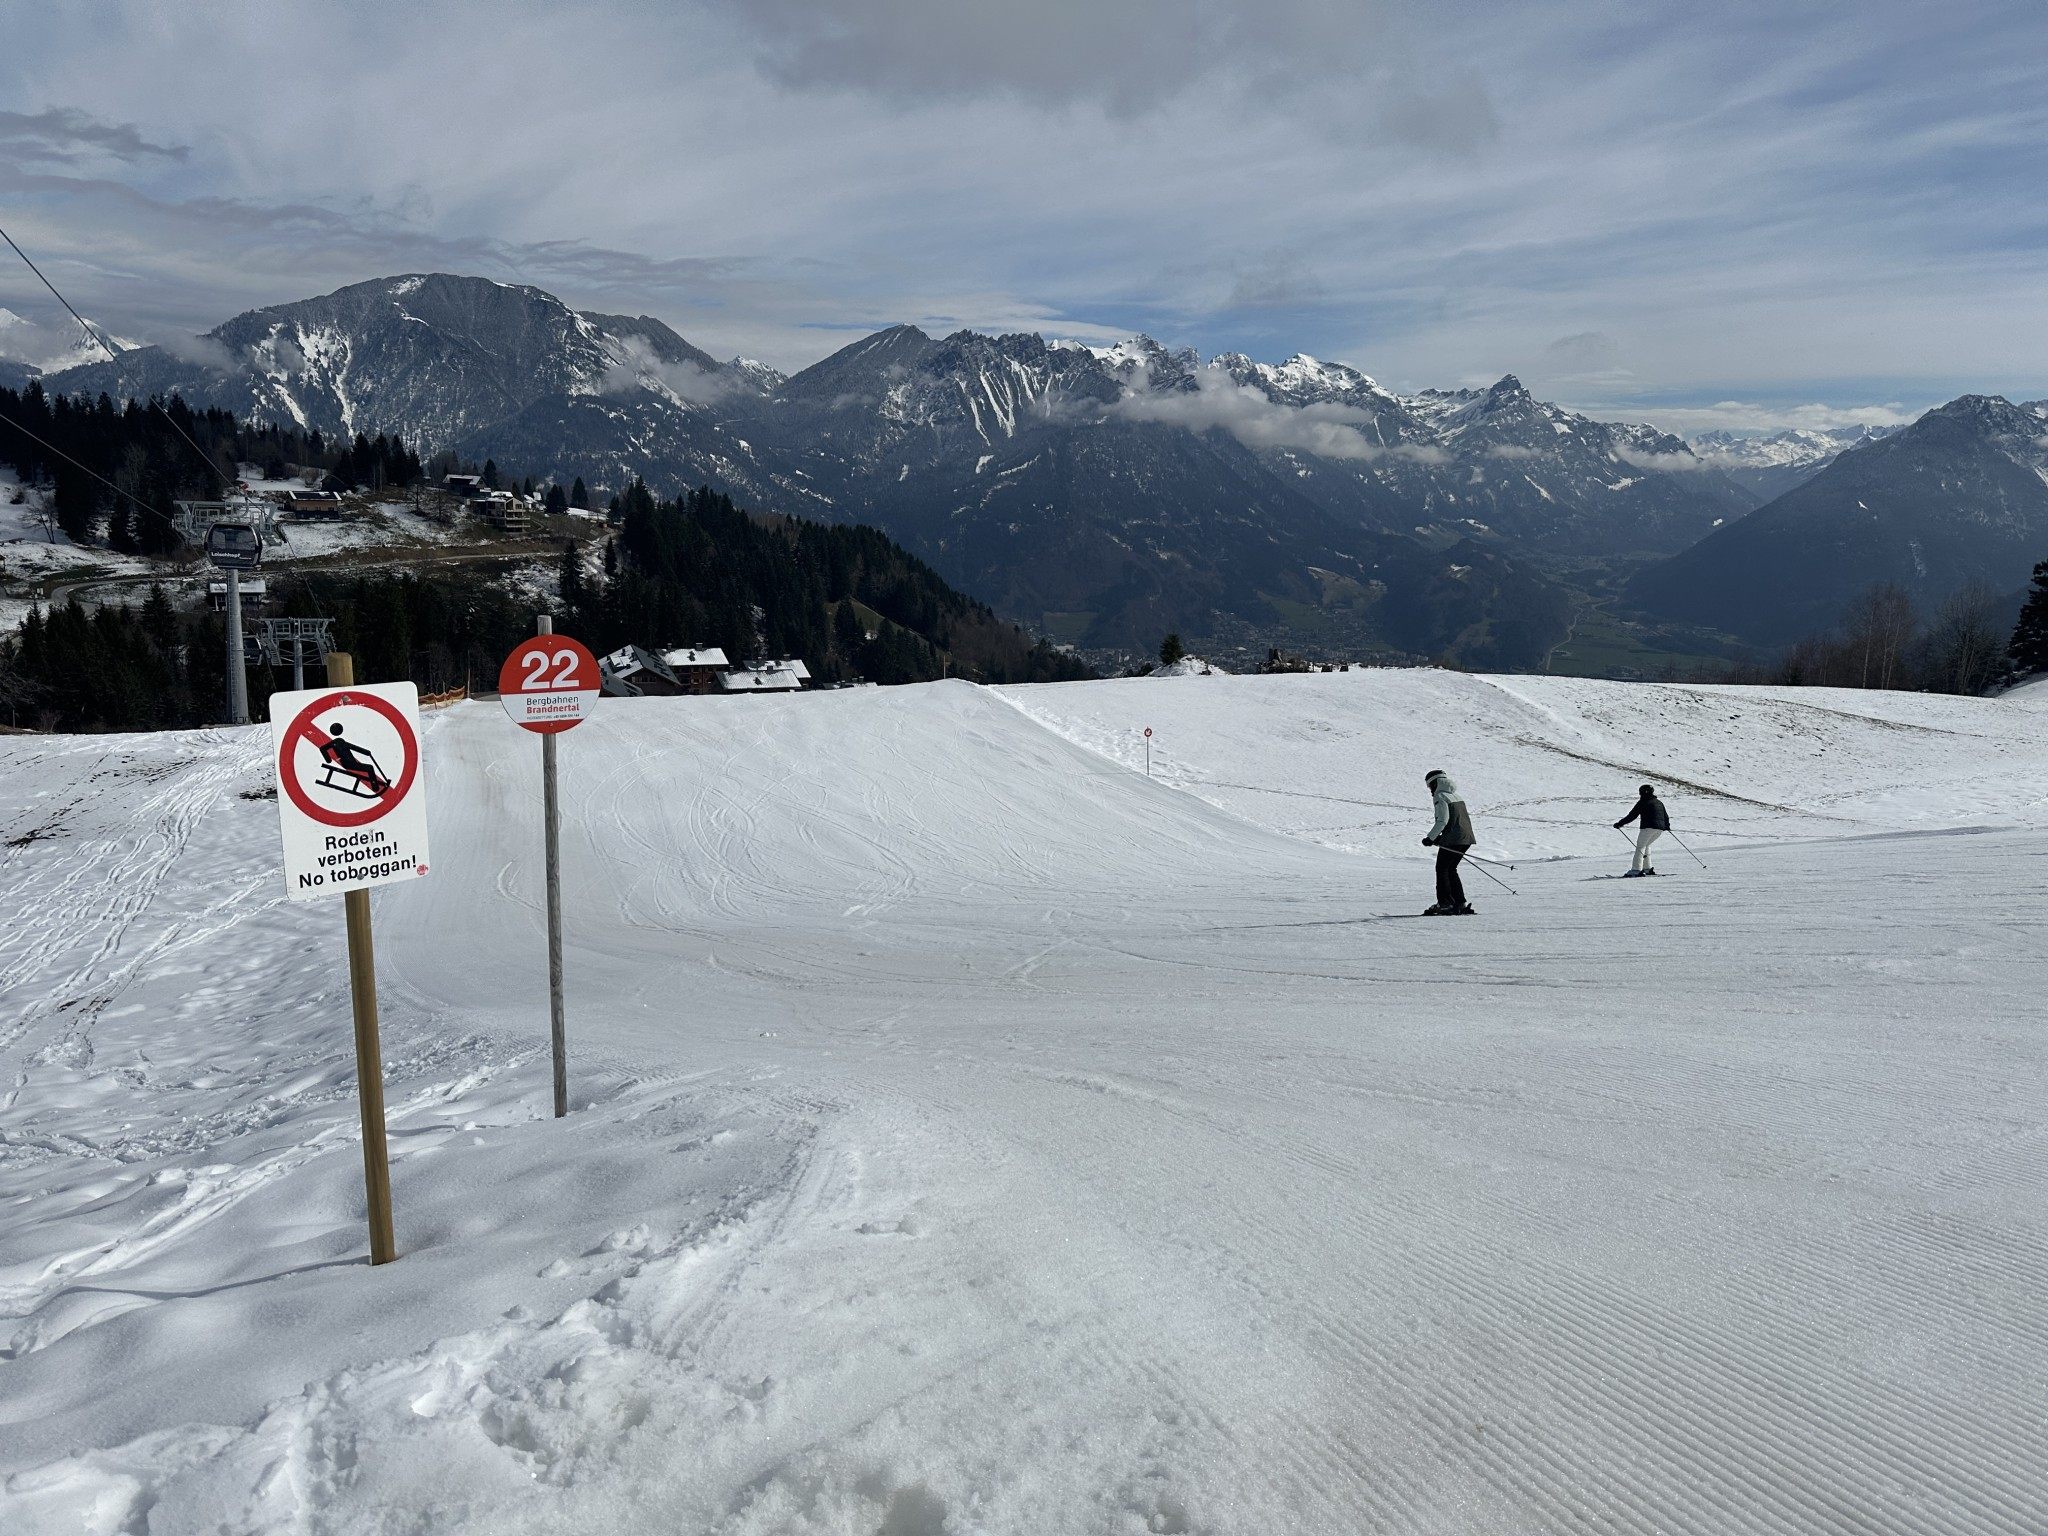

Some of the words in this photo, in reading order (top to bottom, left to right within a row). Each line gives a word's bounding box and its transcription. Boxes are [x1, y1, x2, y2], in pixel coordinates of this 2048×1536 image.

[521, 649, 580, 691] 22
[526, 695, 579, 707] Bergbahnen
[526, 703, 580, 714] Brandnertal
[318, 841, 398, 868] verboten!
[299, 872, 324, 889] No
[330, 854, 417, 883] toboggan!
